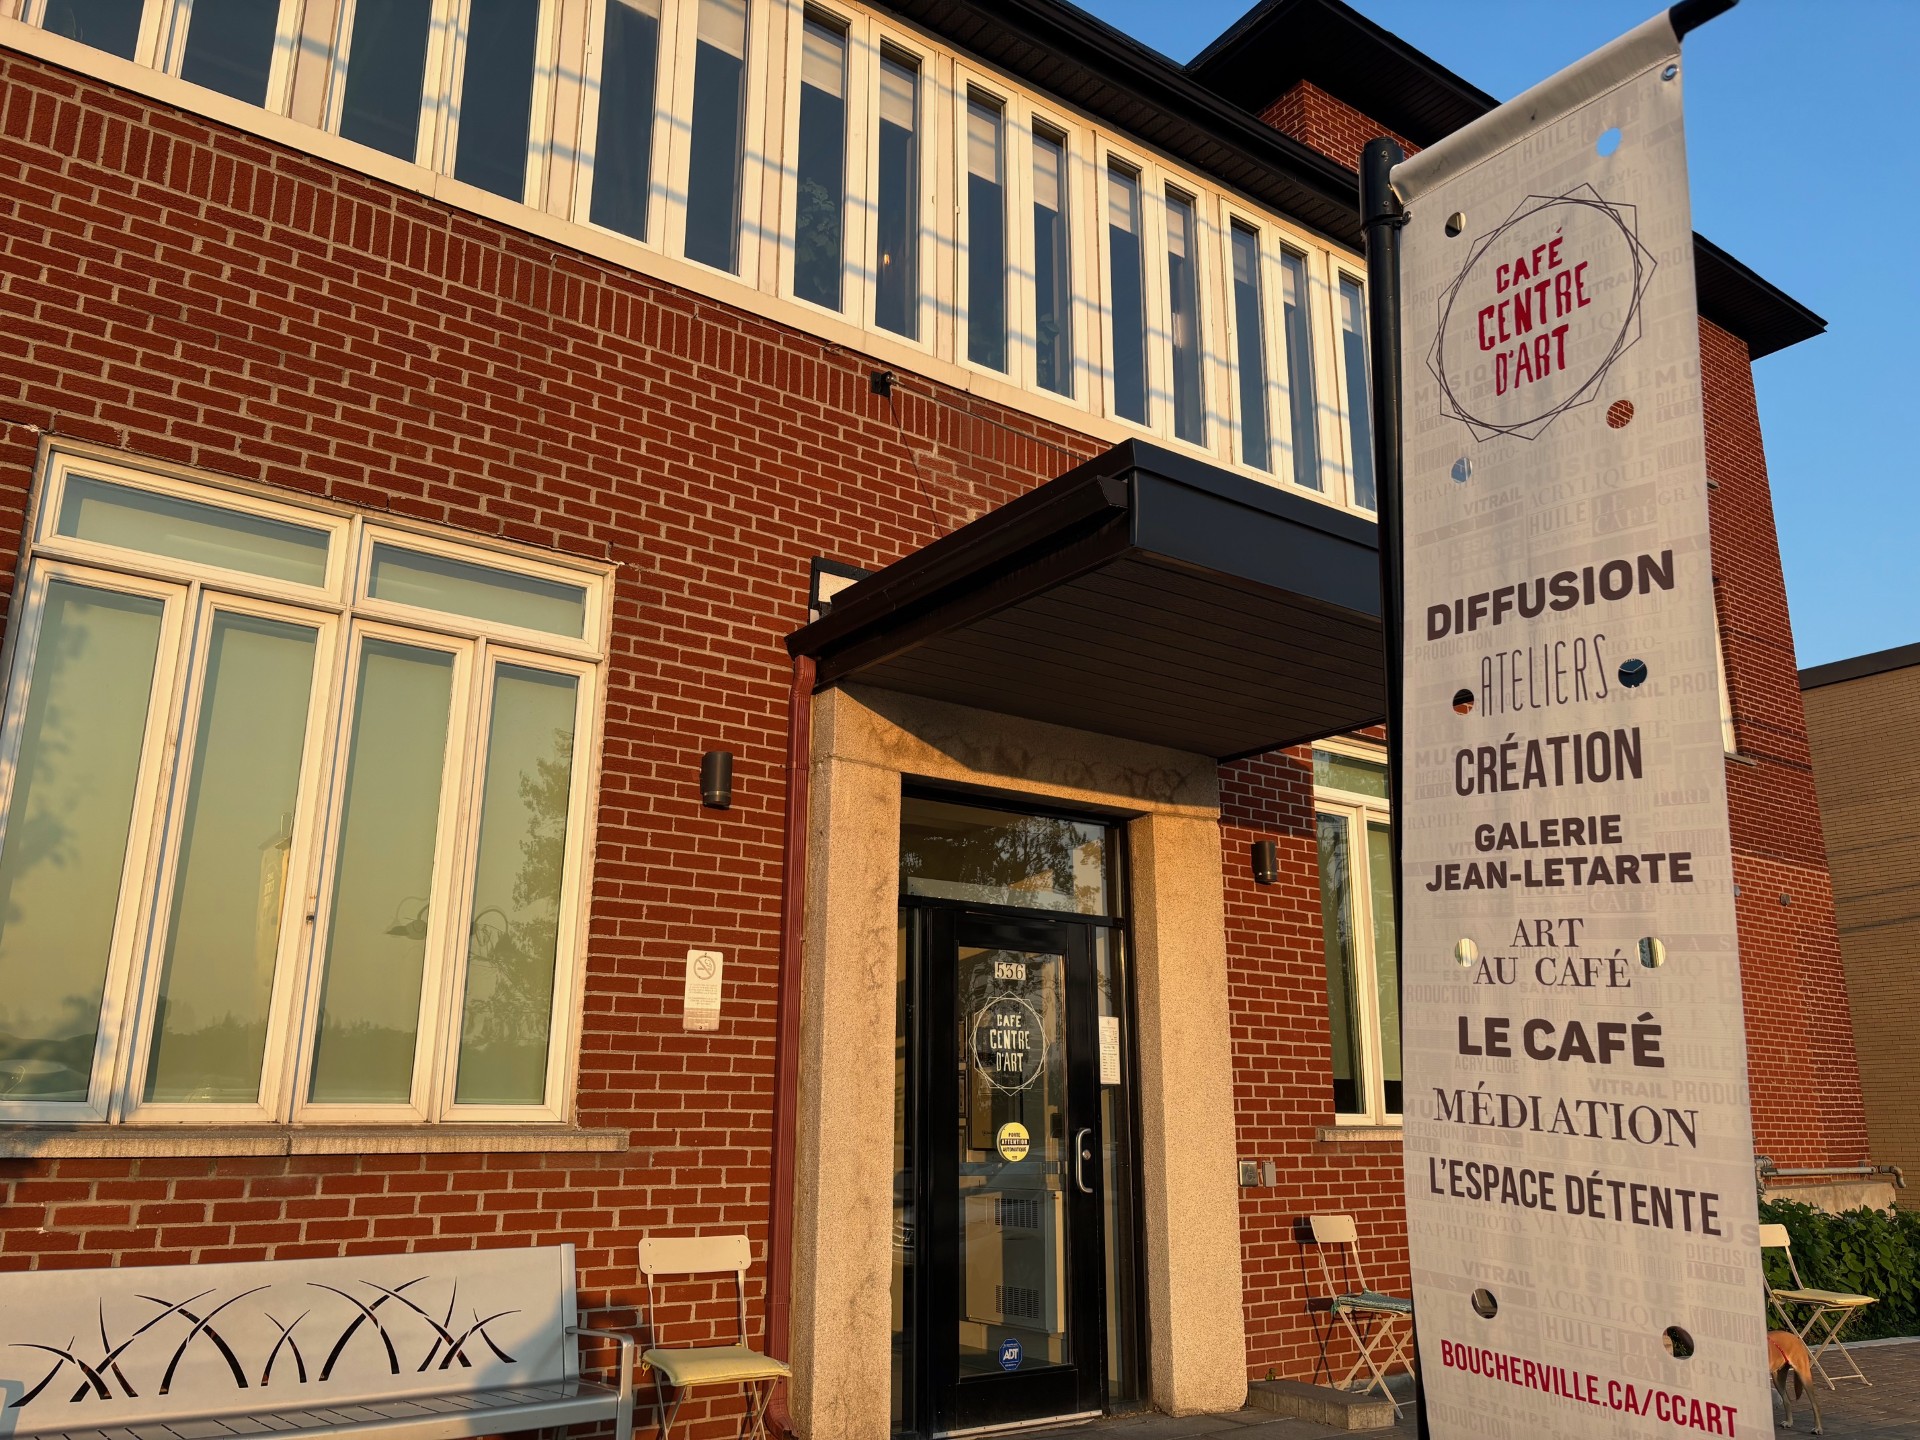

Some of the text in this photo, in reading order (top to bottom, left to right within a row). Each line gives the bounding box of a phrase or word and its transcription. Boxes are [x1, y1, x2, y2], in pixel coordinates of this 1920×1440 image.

[1496, 227, 1563, 293] CAFÉ
[1478, 261, 1591, 351] CENTRE
[1496, 324, 1569, 396] D'ART
[1463, 486, 1523, 516] VITRAIL
[1529, 458, 1655, 508] ACRYLIQUE
[1530, 501, 1587, 537] HUILE
[1427, 549, 1675, 641] DIFFUSION
[1415, 631, 1493, 664] PRODUCTION
[1482, 634, 1608, 718] ATELIERS
[1456, 727, 1642, 796] CRÉATION
[1475, 814, 1623, 853] GALERIE
[1426, 852, 1693, 891] JEAN-LETARTE
[1509, 918, 1584, 948] ART
[997, 962, 1025, 980] 536
[1472, 956, 1519, 985] AU
[1534, 949, 1631, 988] CAFÉ
[997, 1012, 1022, 1028] CAFÉ
[990, 1029, 1031, 1050] CENTRE
[1459, 1012, 1664, 1068] LE CAFÉ
[1672, 1043, 1732, 1071] HUILE
[996, 1052, 1024, 1072] D'ART
[1588, 1077, 1668, 1099] VITRAIL
[1433, 1081, 1698, 1148] MÉDIATION
[1430, 1157, 1721, 1236] L'ESPACE DÉTENTE
[1465, 1211, 1528, 1234] PHOTO-
[1535, 1237, 1609, 1271] DUCTION
[1461, 1259, 1536, 1288] VITRAIL
[1536, 1261, 1685, 1309] MUSIQUE
[1546, 1315, 1613, 1352] HUILE
[1002, 1348, 1019, 1361] ADT
[1441, 1339, 1738, 1438] BOUCHERVILLE.CA/CCART
[1468, 1395, 1551, 1430] ESTAMPE
